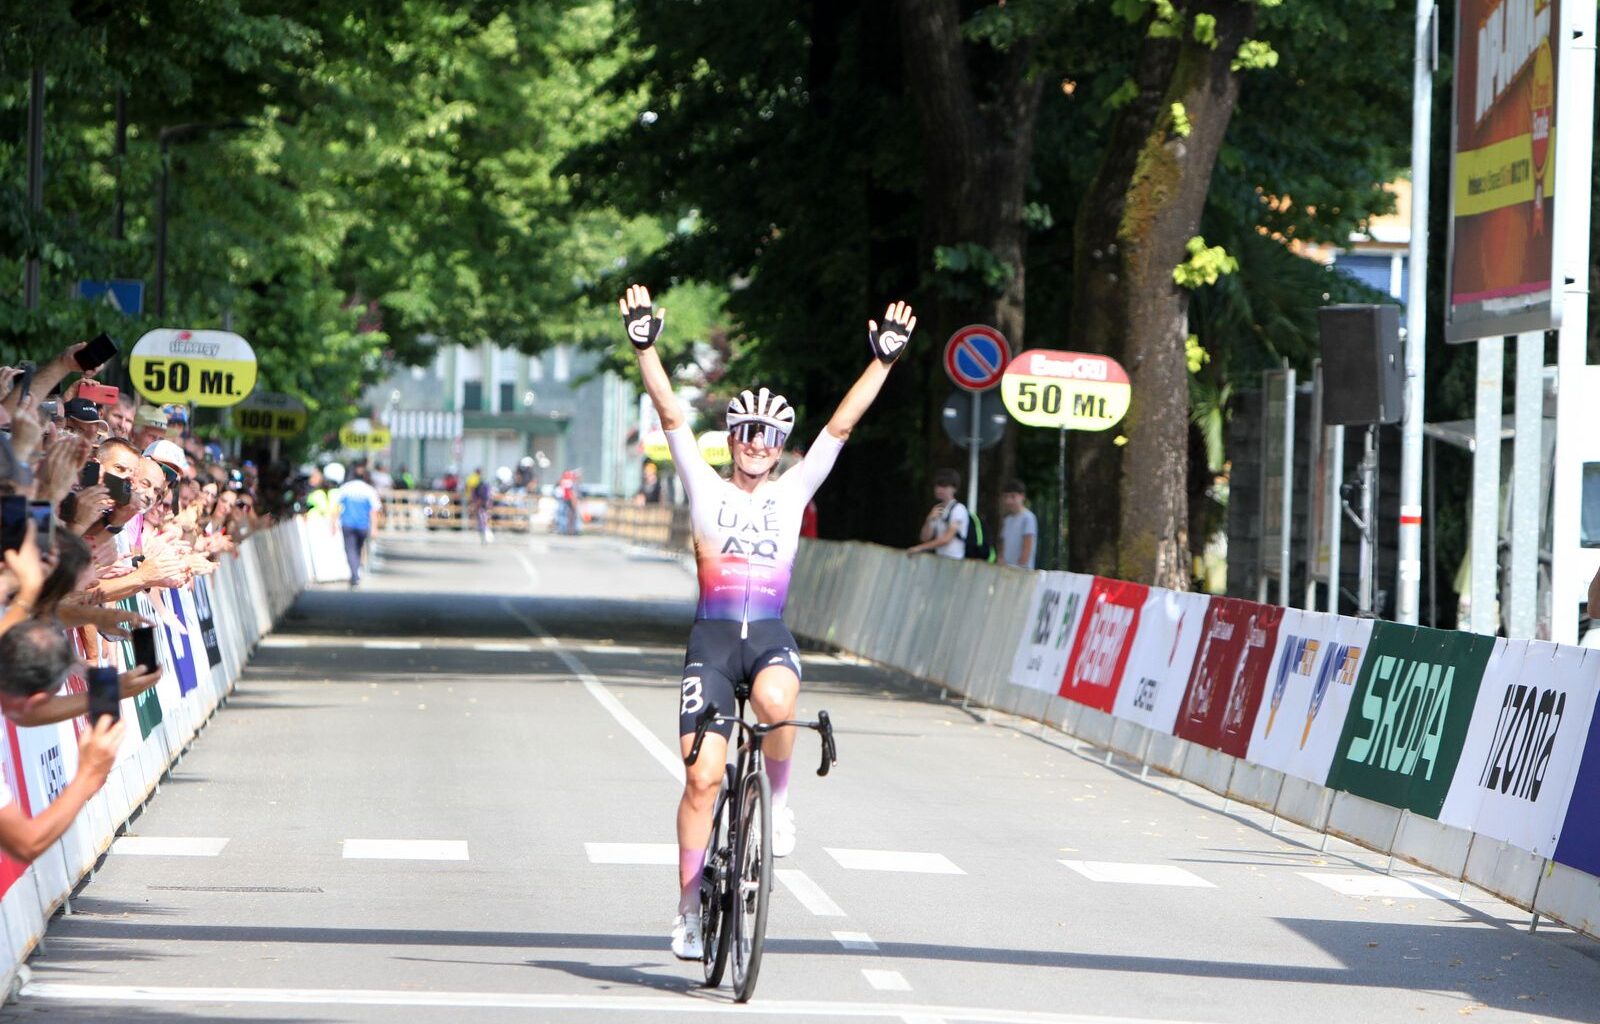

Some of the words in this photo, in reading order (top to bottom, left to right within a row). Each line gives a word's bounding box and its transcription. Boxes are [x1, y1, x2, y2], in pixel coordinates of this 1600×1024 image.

[143, 360, 190, 393] 50
[200, 370, 242, 396] Mt.
[1017, 382, 1062, 415] 50
[1072, 393, 1113, 419] Mt.
[240, 409, 272, 428] 100
[717, 507, 780, 533] UAE
